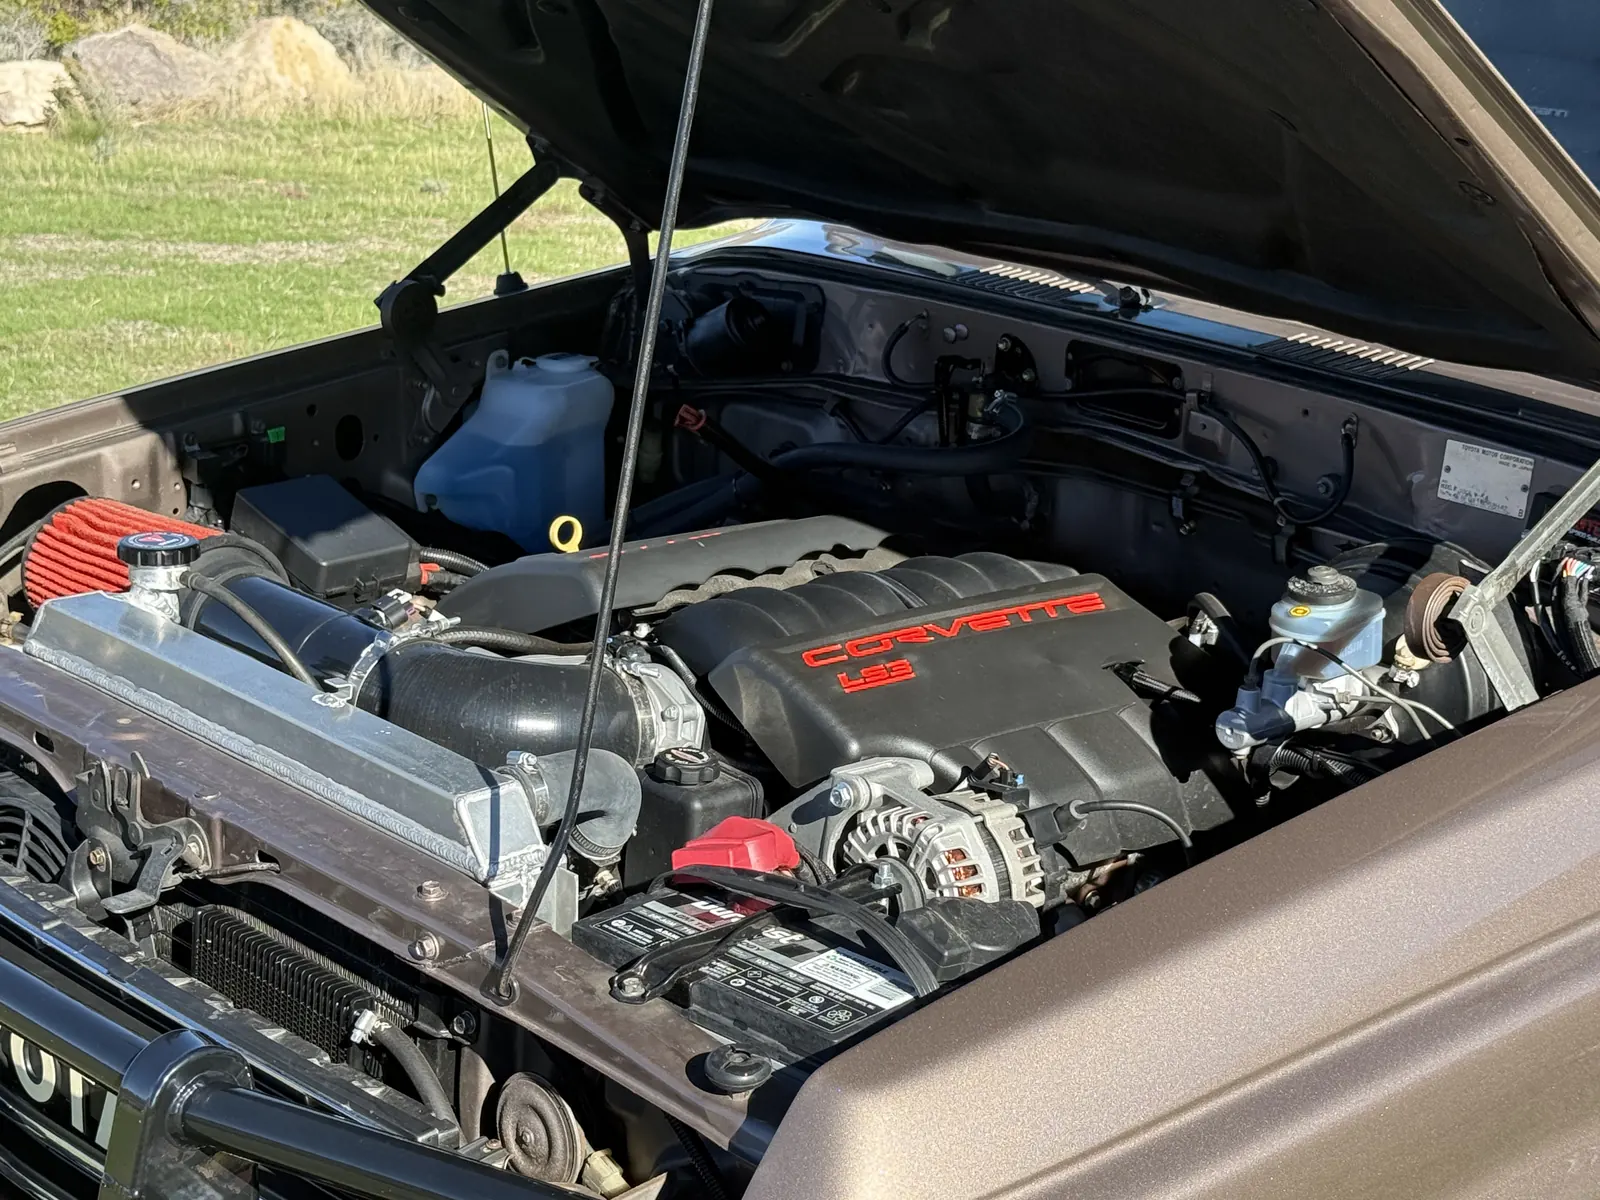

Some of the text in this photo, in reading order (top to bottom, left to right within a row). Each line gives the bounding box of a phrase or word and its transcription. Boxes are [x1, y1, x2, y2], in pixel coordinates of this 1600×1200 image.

[1462, 444, 1534, 466] TOYOTA MOTOR CORPORATION
[802, 592, 1106, 667] CORVETTE
[837, 658, 916, 691] LS3
[0, 1025, 118, 1151] OT
